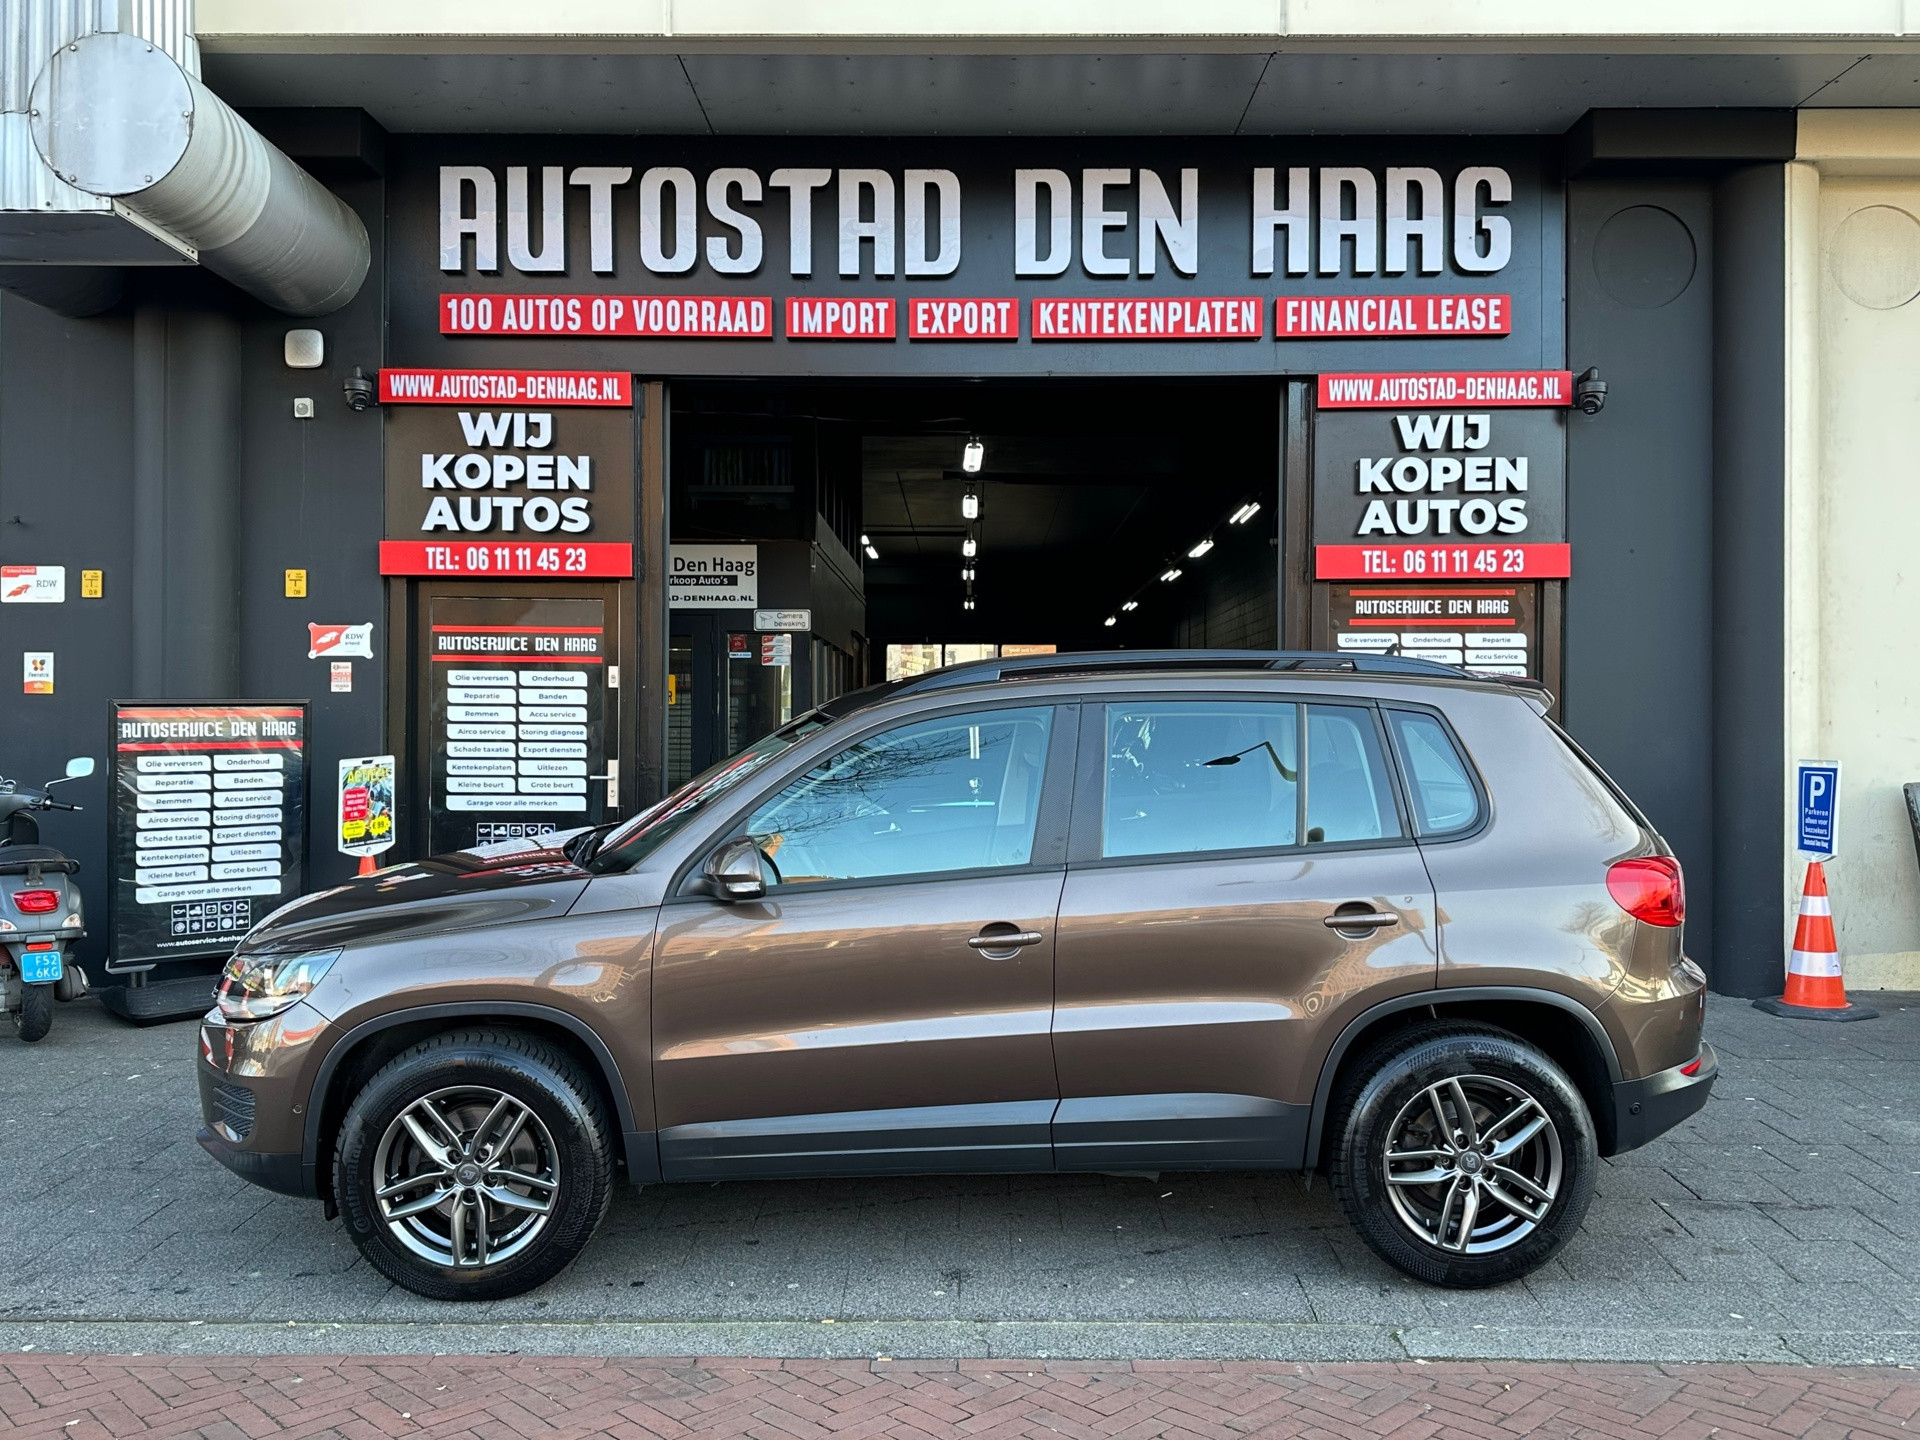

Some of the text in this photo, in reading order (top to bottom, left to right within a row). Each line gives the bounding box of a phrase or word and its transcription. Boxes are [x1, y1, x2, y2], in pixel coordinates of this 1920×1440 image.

[439, 165, 1512, 276] AUTOSTAD DEN HAAG
[447, 298, 767, 333] 100 AUTOS OP VOORRAAD
[792, 301, 889, 334] IMPORT
[916, 300, 1011, 335] EXPORT
[1039, 301, 1256, 334] KENTEKENPLATEN
[1286, 298, 1502, 333] FINANCIAL LEASE
[390, 374, 621, 400] WWW.AUTOSTAD-DENHAAG.NL
[1328, 377, 1562, 402] WWW.AUTOSTAD-DENHAAG.NL
[458, 412, 552, 448] WIJ
[1395, 414, 1491, 449] WIJ
[422, 454, 590, 490] KOPEN
[1359, 457, 1528, 492] KOPEN
[421, 497, 590, 533] AUTOS
[1358, 498, 1528, 535] AUTOS
[426, 547, 586, 571] TEL: 06 11 11 45 23
[674, 558, 755, 576] Den Haag
[1363, 549, 1524, 573] TEL: 06 11 11 45 23
[699, 577, 728, 585] Auto's
[1356, 600, 1509, 614] AUTOSERVICE DEN HAAG
[439, 636, 596, 652] AUTOSERVICE DEN HAAG
[455, 674, 470, 682] Olie
[122, 721, 296, 738] AUTOSERVICE DEN HAAG
[146, 760, 162, 768] Olie
[227, 758, 270, 766] Onderhoud
[155, 779, 193, 787] Reparatie
[224, 795, 243, 803] Accu
[1810, 776, 1825, 808] P
[156, 797, 192, 805] Remmen
[215, 812, 279, 822] Storing diagnose
[1805, 808, 1828, 816] Parkeren
[143, 833, 203, 842] Schade taxatie
[217, 829, 276, 840] Export diensten
[141, 852, 204, 861] Kentekenplaten
[148, 870, 196, 879] Kleine beurt
[247, 865, 267, 873] beurt
[157, 890, 185, 898] Garage
[222, 885, 251, 893] merken
[35, 955, 57, 966] F52
[36, 967, 58, 978] 6KG
